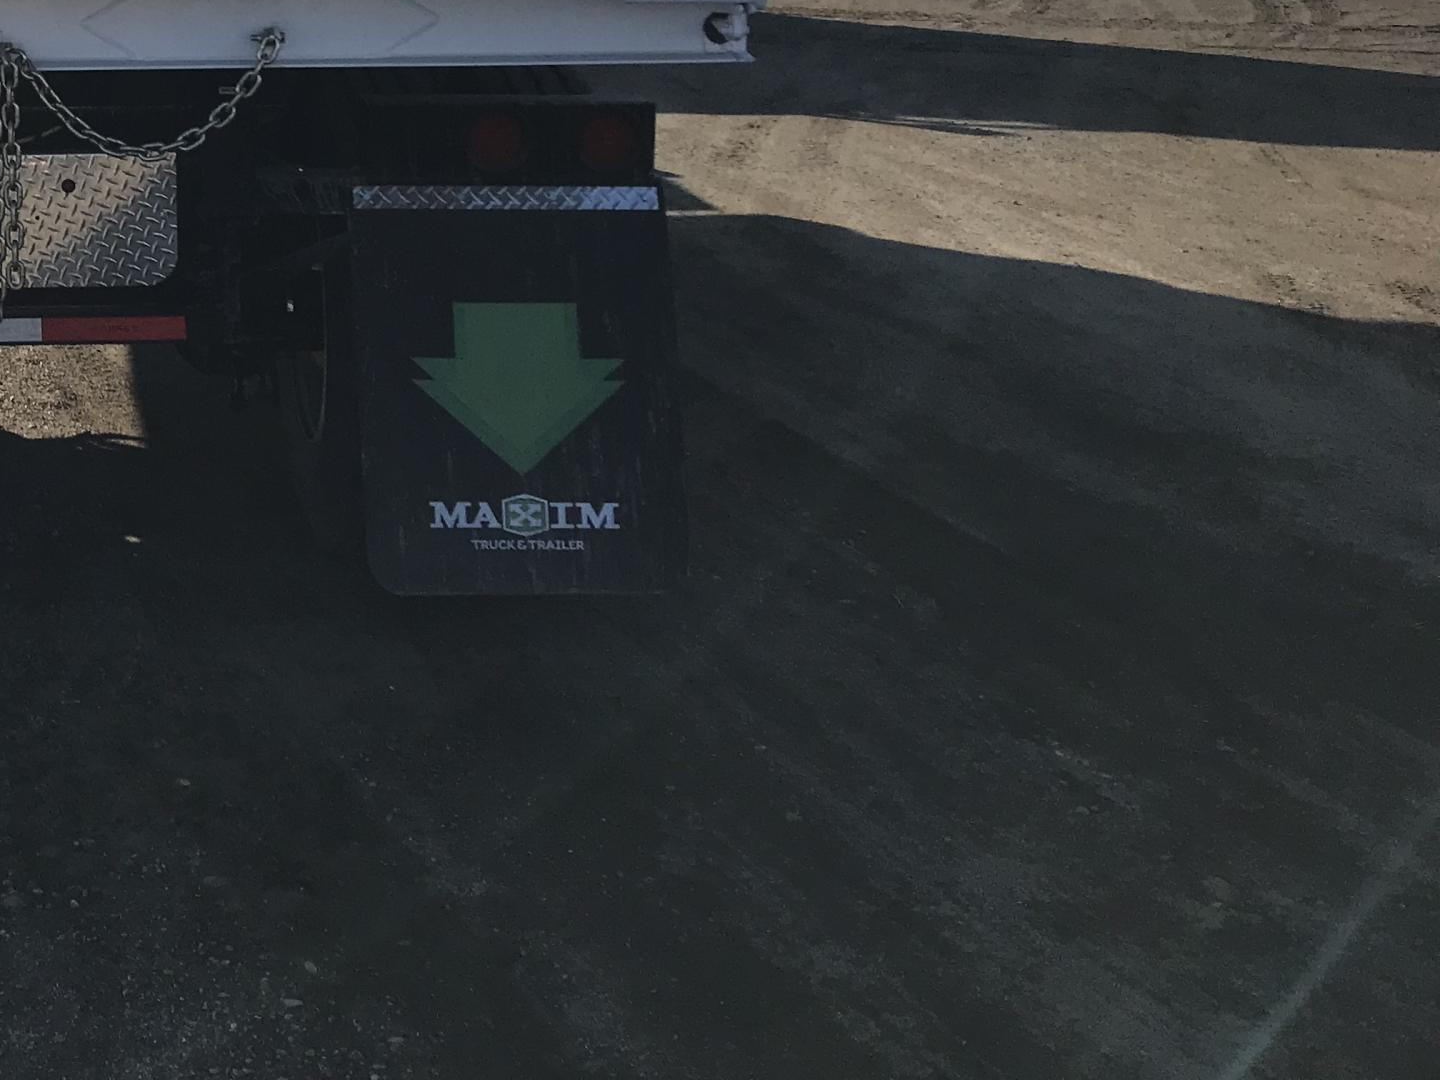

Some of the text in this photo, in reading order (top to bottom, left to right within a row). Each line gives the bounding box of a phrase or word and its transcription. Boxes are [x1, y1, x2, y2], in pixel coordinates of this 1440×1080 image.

[429, 500, 620, 529] MAXIM
[471, 540, 585, 551] TRUCK & TRAILER
